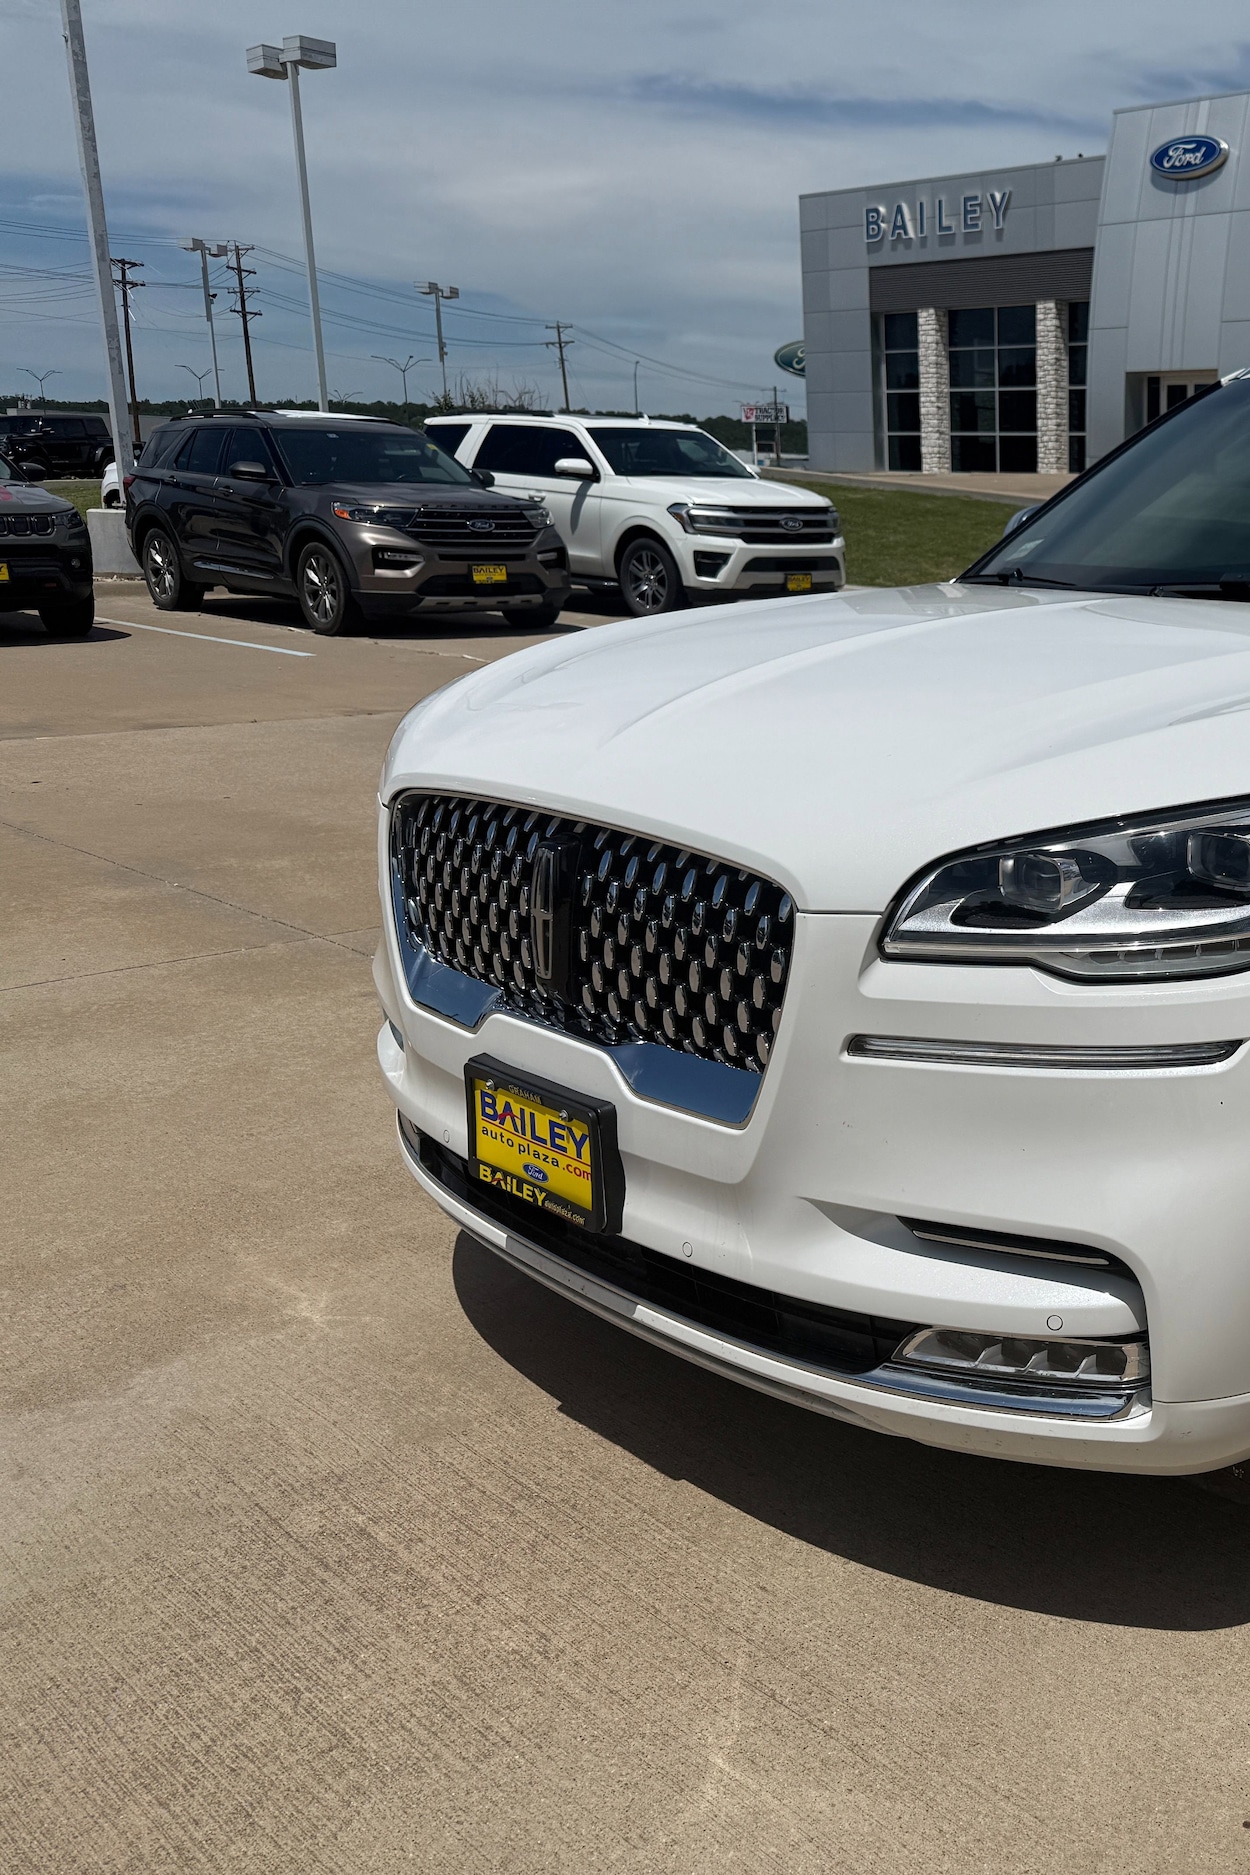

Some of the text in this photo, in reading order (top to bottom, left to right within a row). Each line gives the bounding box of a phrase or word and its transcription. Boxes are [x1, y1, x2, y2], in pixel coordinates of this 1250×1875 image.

[1163, 143, 1207, 168] Ford
[864, 190, 1012, 242] BAILEY
[473, 566, 504, 574] BAILEY
[508, 1084, 543, 1105] GRAHAM
[480, 1089, 588, 1160] BAILEY
[482, 1125, 514, 1148] auto
[526, 1165, 544, 1180] Ford
[480, 1163, 547, 1207] BAILEY
